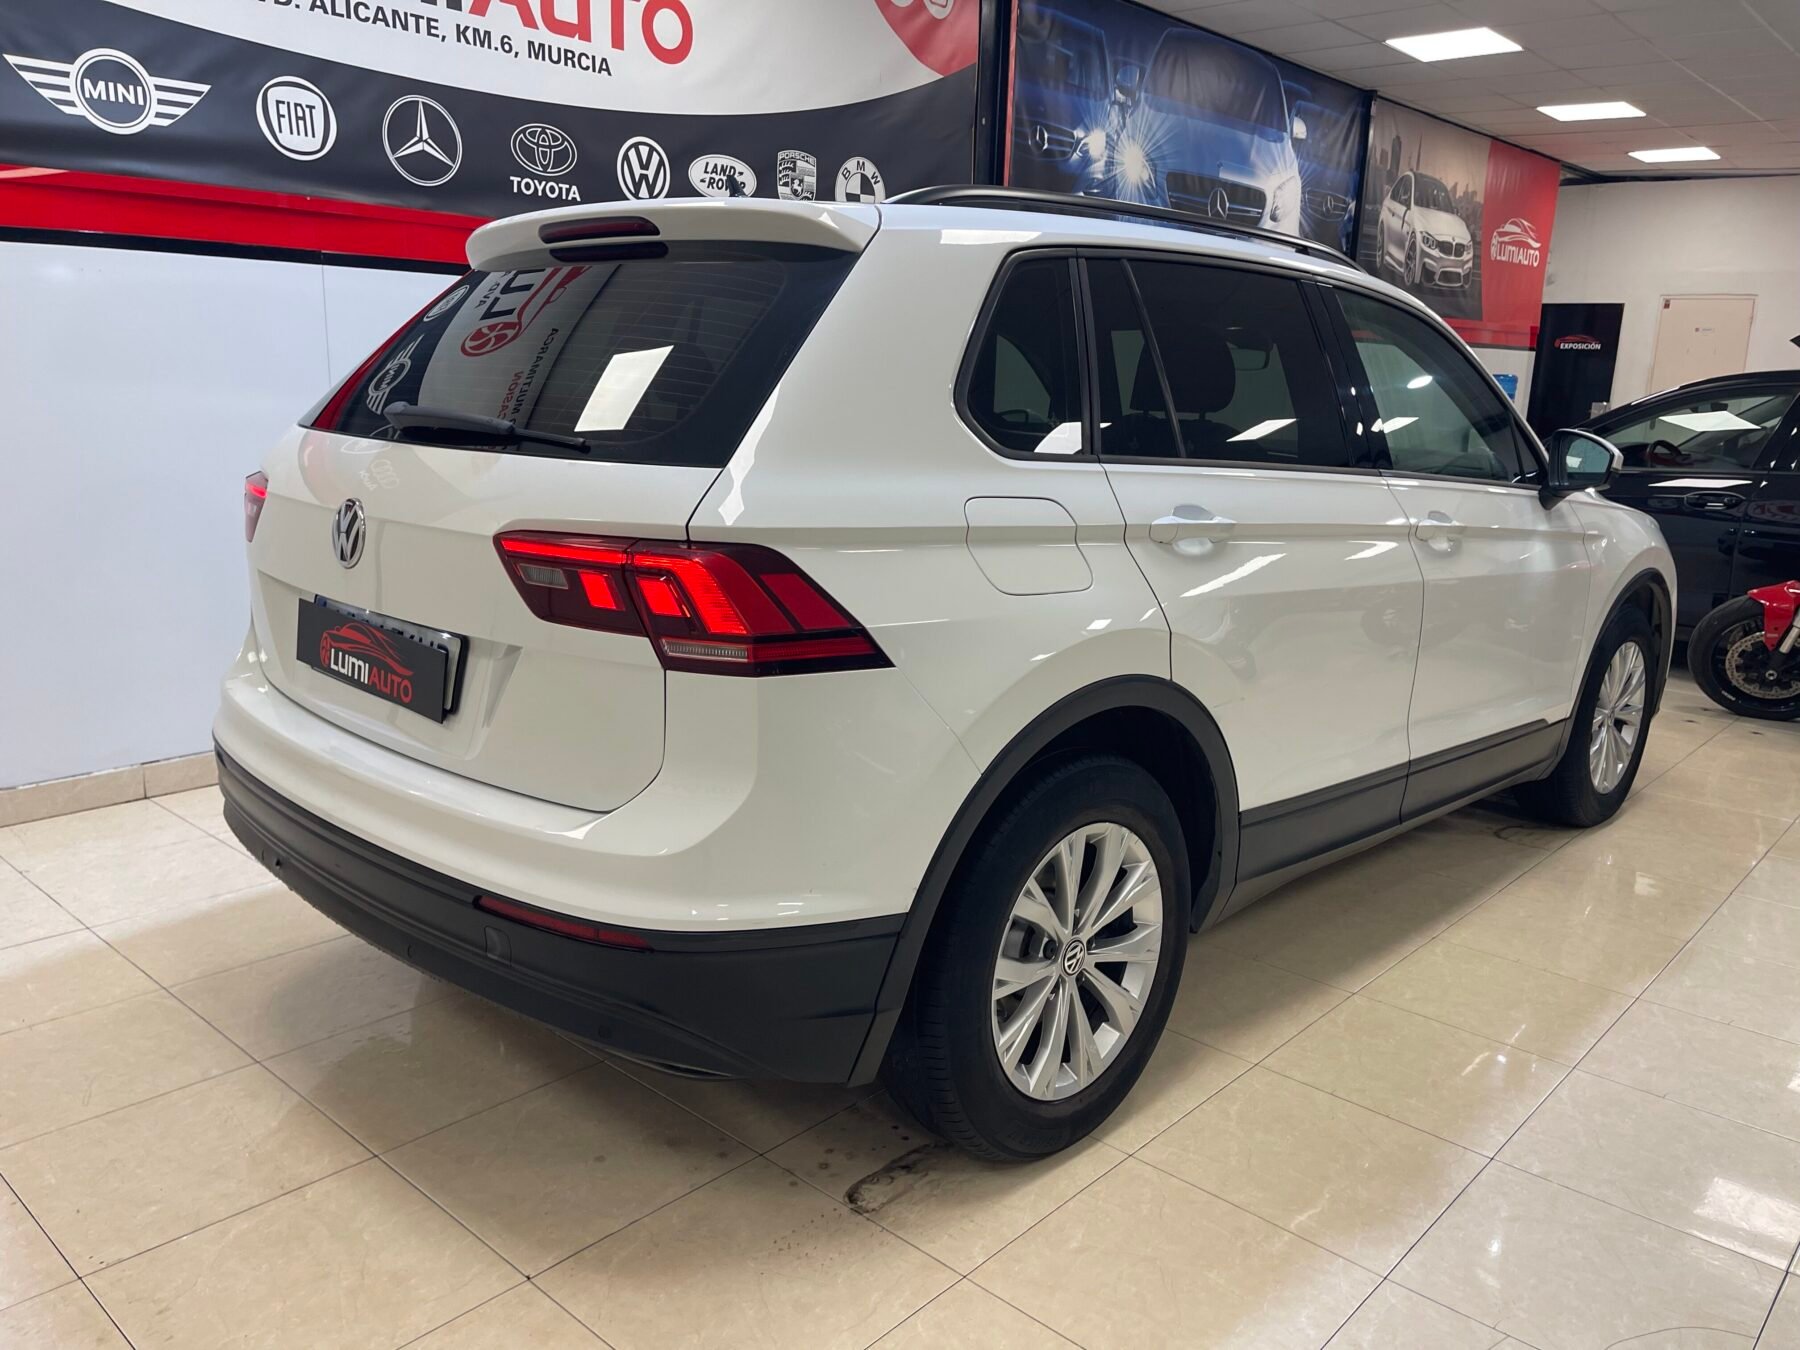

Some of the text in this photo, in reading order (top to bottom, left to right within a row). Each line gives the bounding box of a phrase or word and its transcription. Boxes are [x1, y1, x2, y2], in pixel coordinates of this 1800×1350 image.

[309, 0, 613, 77] ALICANTE, KM.6, MURCIA
[83, 78, 145, 106] MINI
[275, 99, 316, 139] FIAT
[779, 151, 816, 166] PORSCHE
[706, 177, 746, 192] ROR
[842, 159, 881, 186] BMW
[509, 176, 582, 202] TOYOTA
[1496, 243, 1540, 268] LUMIAUTO
[1559, 341, 1602, 350] EXPOSICIÓN
[330, 647, 413, 704] LUMIAUTO
